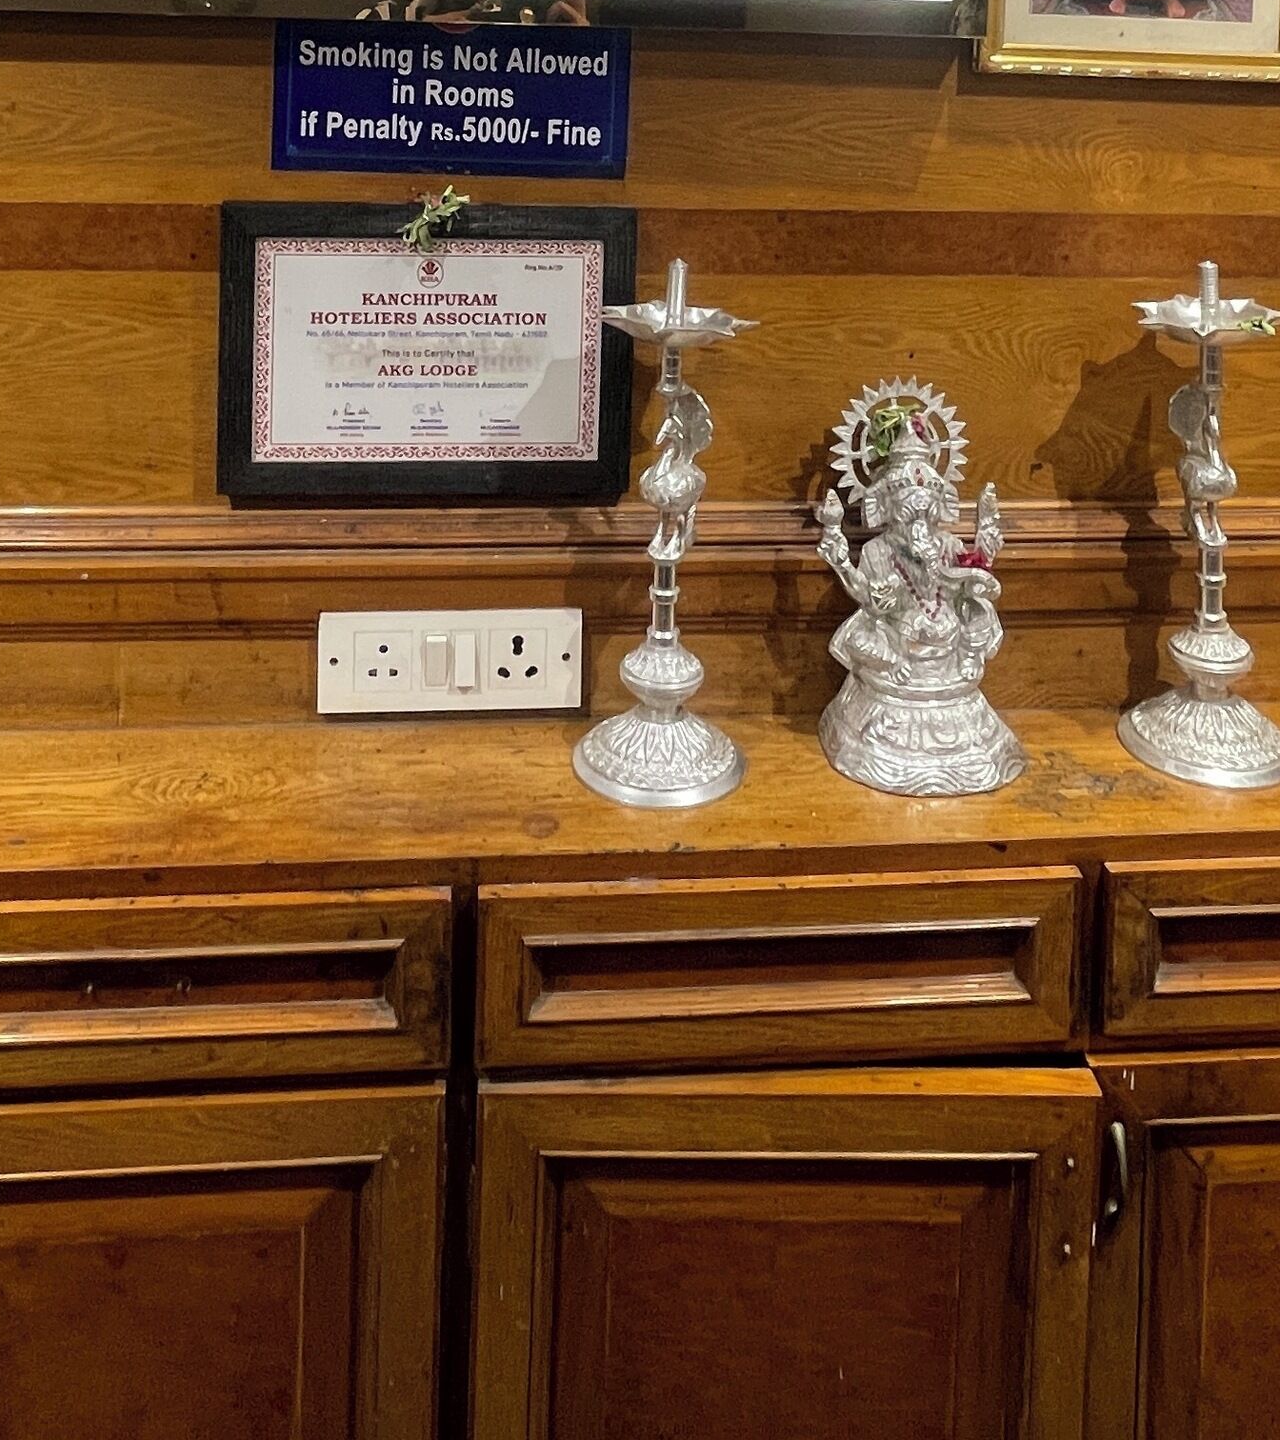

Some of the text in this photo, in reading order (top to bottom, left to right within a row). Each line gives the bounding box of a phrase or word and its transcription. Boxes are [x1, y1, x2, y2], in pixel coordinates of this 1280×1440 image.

[298, 39, 609, 77] Smoking is Not Allowed
[391, 78, 515, 109] in Rooms
[299, 110, 319, 138] if
[326, 111, 423, 147] Penalty
[547, 118, 602, 147] Fine
[361, 293, 498, 307] KANCHIPURAM
[310, 311, 548, 326] HOTELIERS ASSOCIATION
[381, 348, 475, 359] This is to Certify that
[377, 364, 479, 377] AKG LODGE
